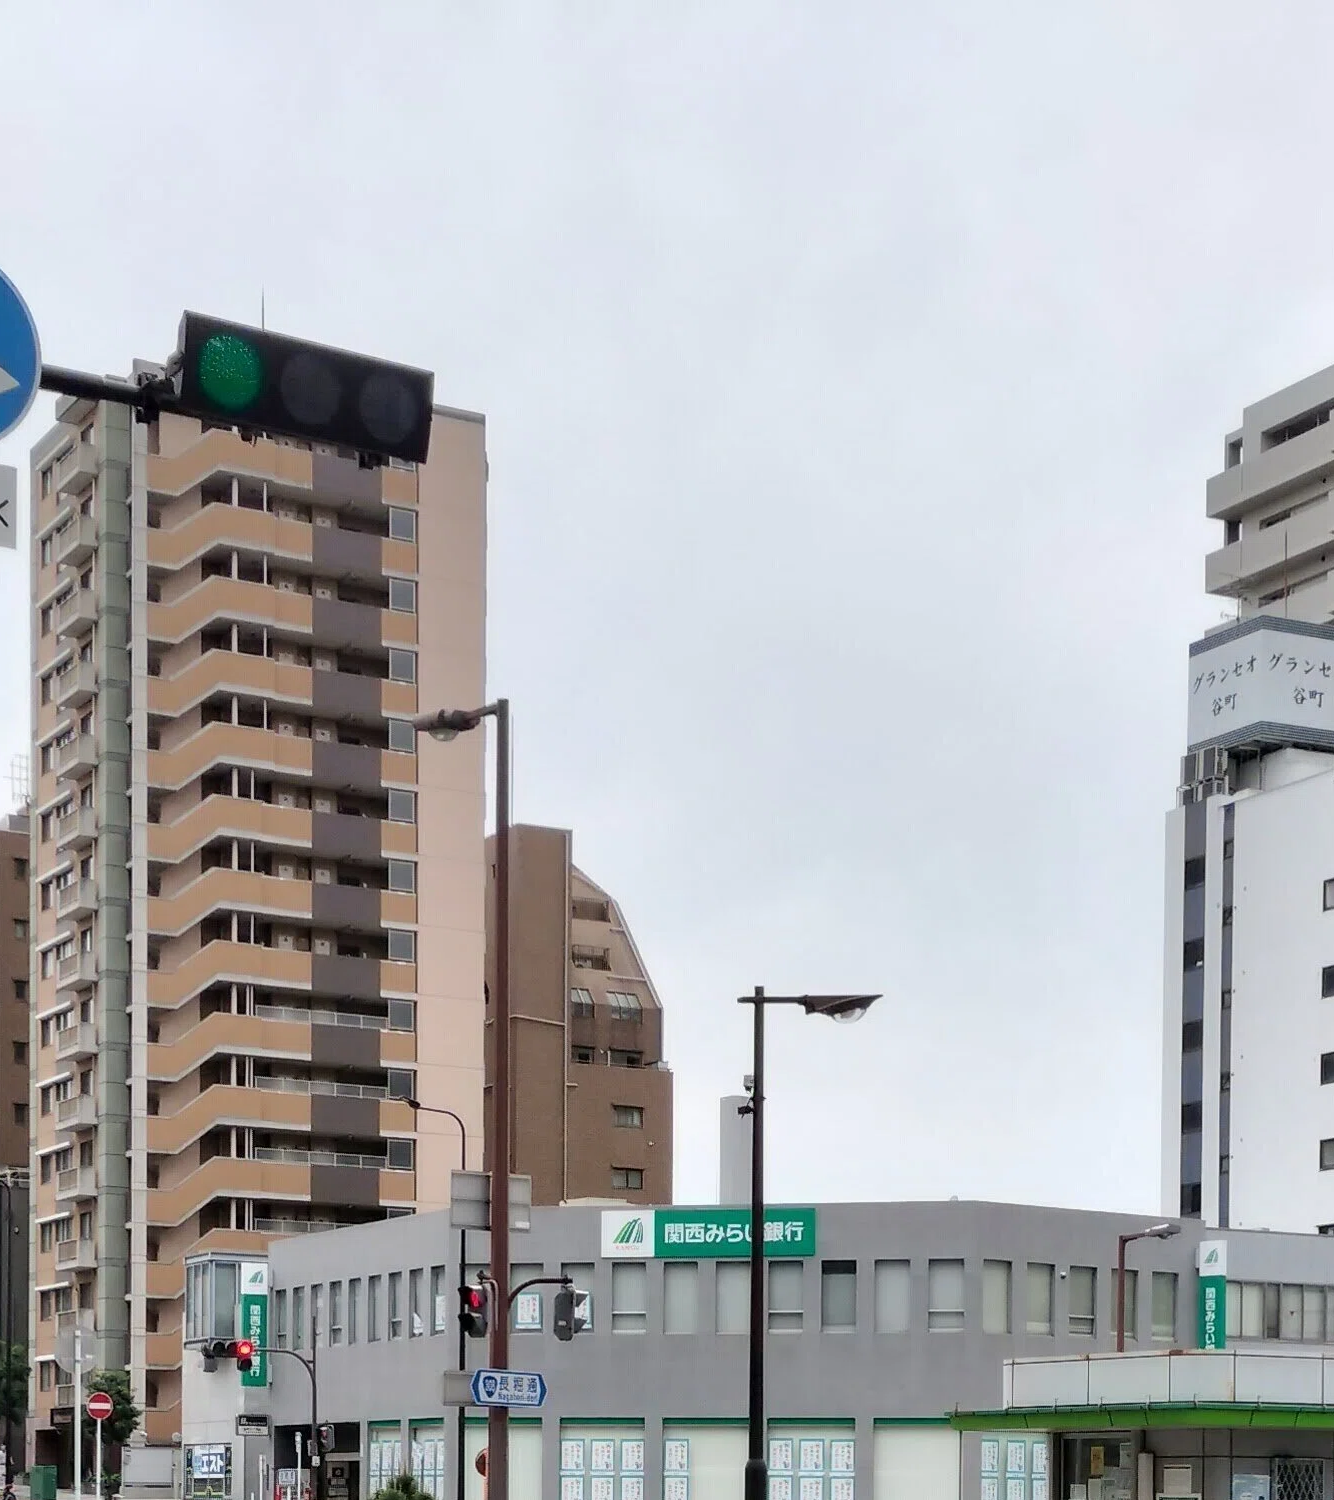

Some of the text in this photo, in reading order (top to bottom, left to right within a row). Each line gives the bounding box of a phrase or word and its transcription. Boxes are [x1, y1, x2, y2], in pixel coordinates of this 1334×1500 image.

[1194, 654, 1257, 695] グランセオ
[1211, 692, 1237, 717] 谷町
[1293, 686, 1325, 709] 谷町
